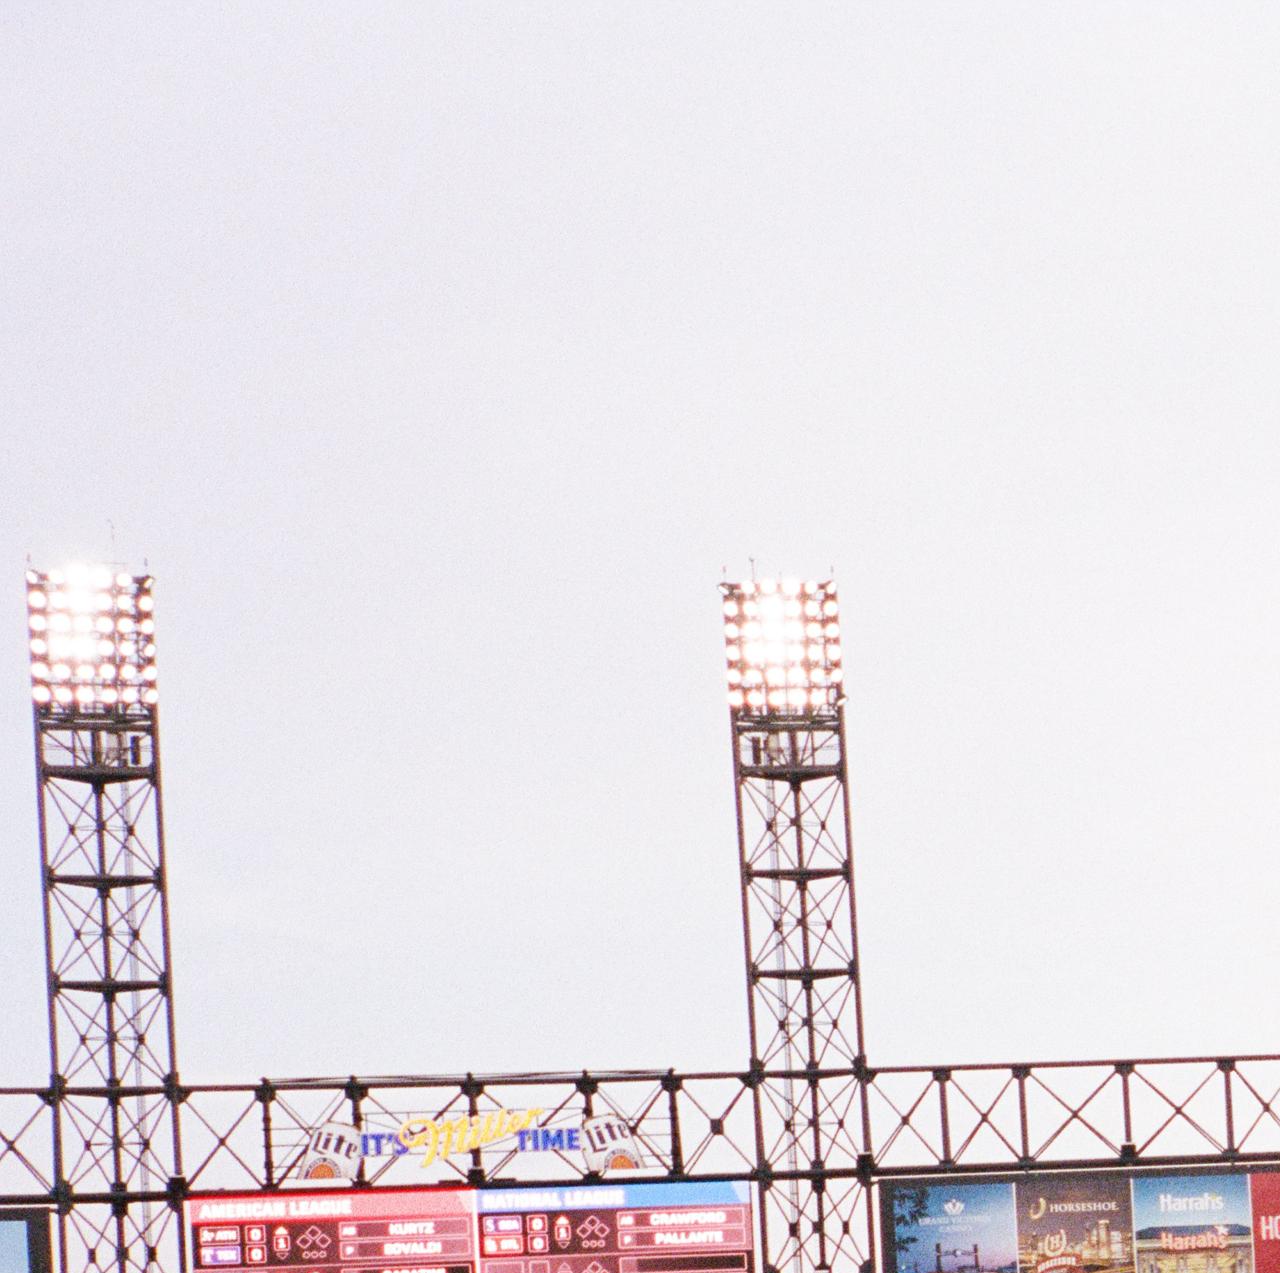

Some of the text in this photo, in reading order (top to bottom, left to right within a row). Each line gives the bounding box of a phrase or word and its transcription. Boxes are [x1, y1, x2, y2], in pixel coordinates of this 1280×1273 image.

[360, 1107, 582, 1169] IT'S Miller TIME
[588, 1117, 632, 1149] Lite
[312, 1129, 360, 1159] Lite
[564, 1189, 626, 1206] LEAGUE
[198, 1197, 352, 1219] AMERICAN LEAGUE
[1049, 1201, 1120, 1213] HORSESHOE
[649, 1212, 726, 1227] CRAWFORD
[388, 1222, 436, 1236] KURTZ
[654, 1231, 725, 1246] PALLANTE
